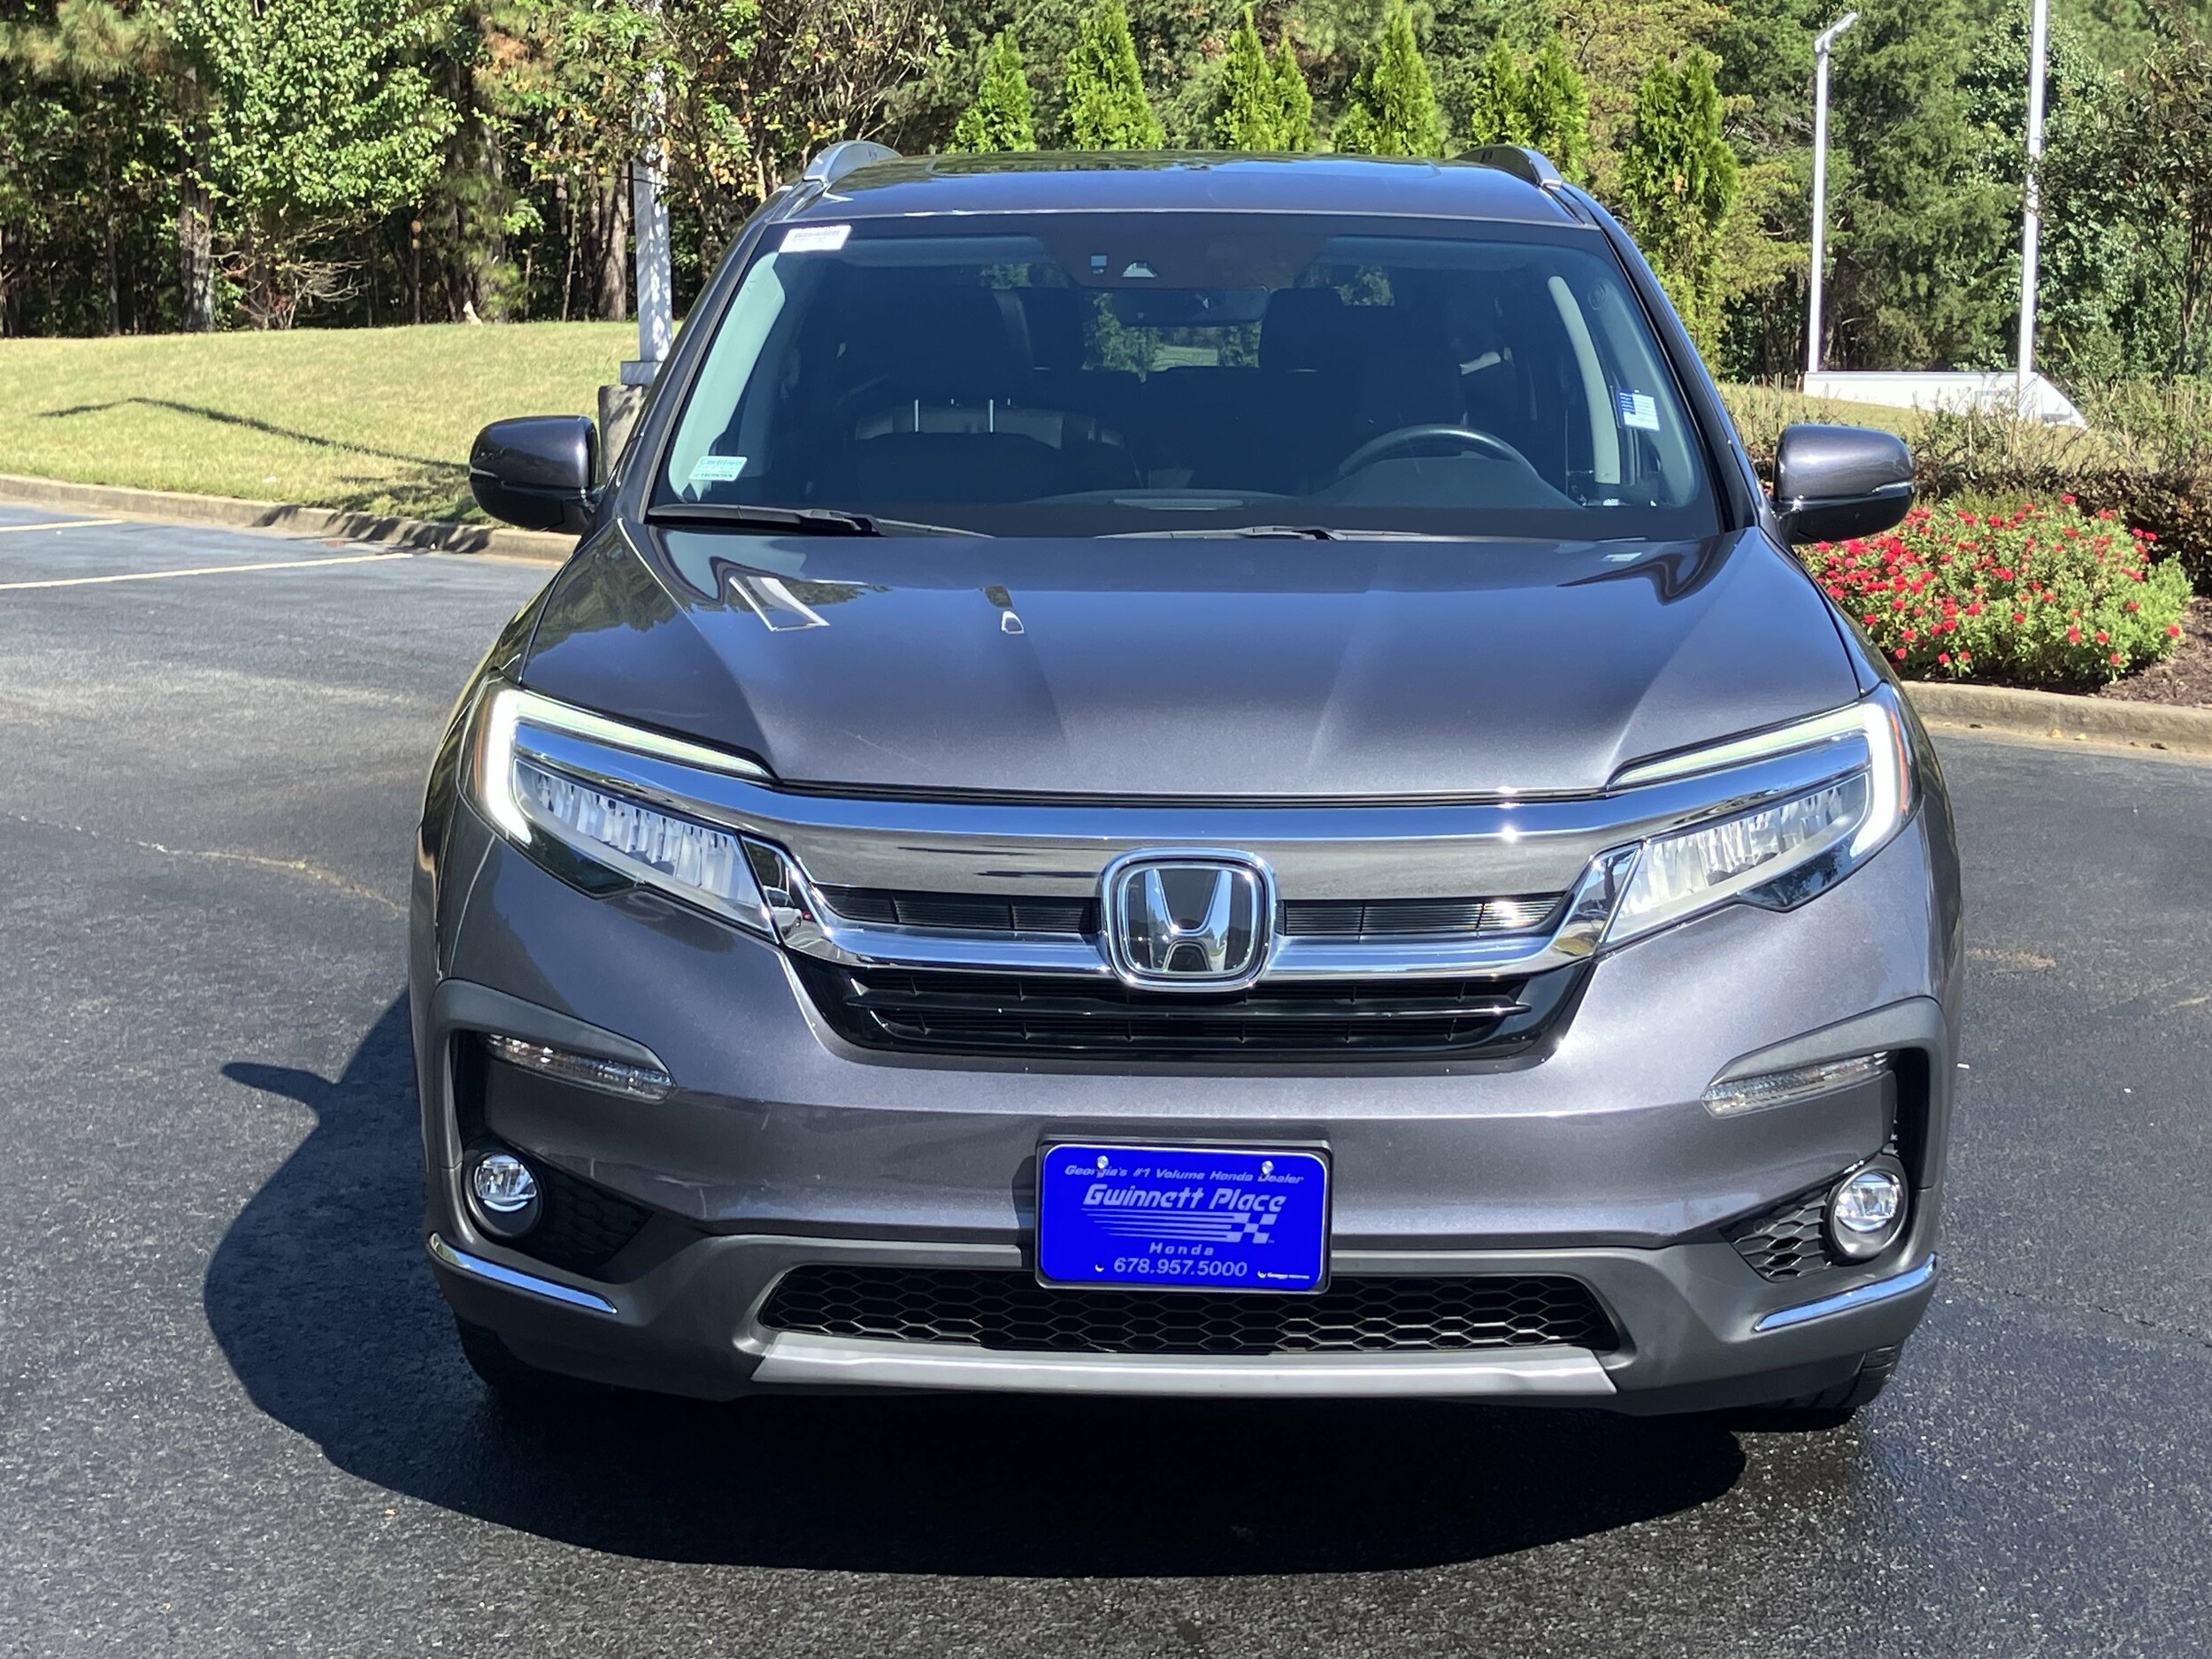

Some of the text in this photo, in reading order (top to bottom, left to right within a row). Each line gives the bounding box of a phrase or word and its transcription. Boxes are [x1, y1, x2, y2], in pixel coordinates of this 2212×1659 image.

[1133, 1167, 1151, 1178] #1
[1156, 1168, 1206, 1179] Volume
[1209, 1171, 1254, 1181] Honda
[1083, 1184, 1287, 1213] Gwinnett Place
[1148, 1241, 1214, 1256] Honda
[1113, 1257, 1248, 1277] 678.957.5000
